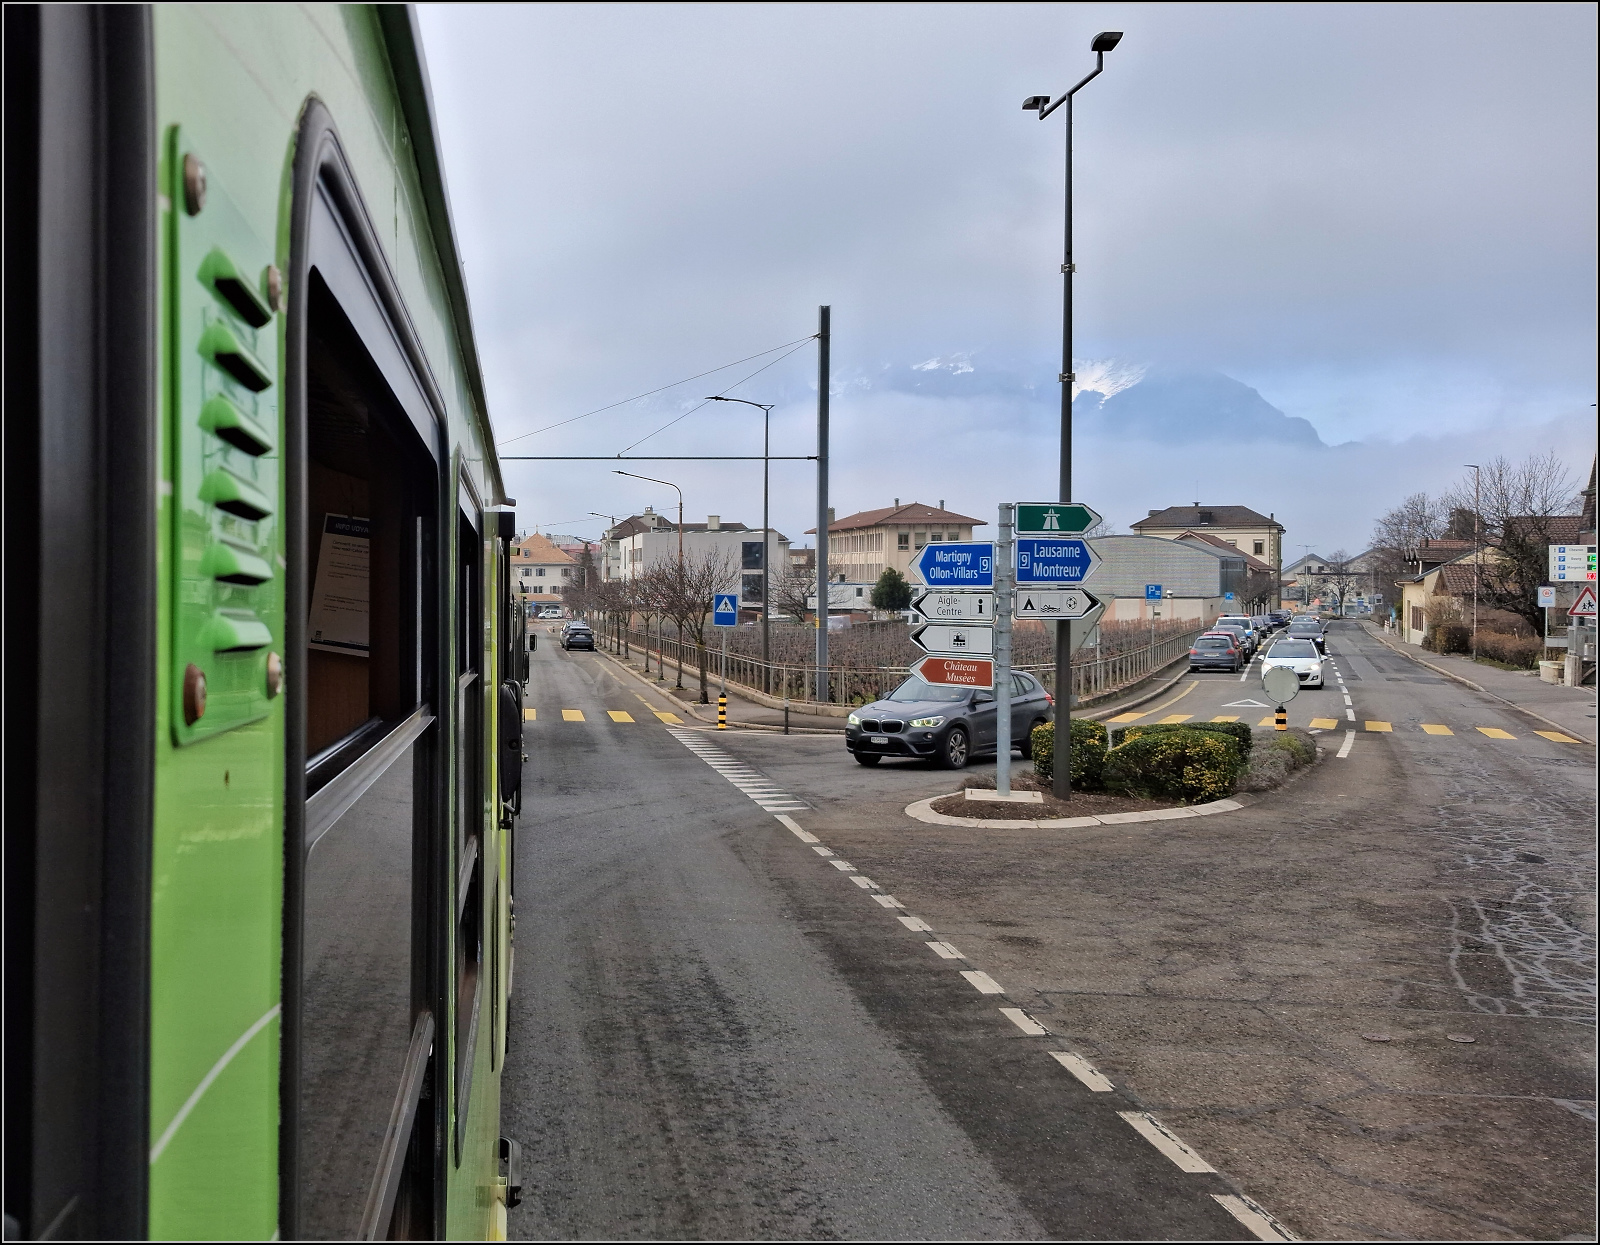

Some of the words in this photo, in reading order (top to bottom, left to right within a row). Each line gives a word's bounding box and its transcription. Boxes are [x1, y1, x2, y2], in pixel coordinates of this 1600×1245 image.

[1034, 542, 1080, 558] Lausanne
[935, 550, 972, 566] Martigny
[981, 558, 989, 571] 9
[1021, 554, 1028, 567] 9
[929, 566, 978, 579] Ollon-Villars
[1033, 562, 1081, 577] Montreux
[937, 595, 961, 606] Aigle-
[936, 606, 962, 616] Centre
[943, 660, 978, 672] Château
[945, 672, 976, 683] Musées
